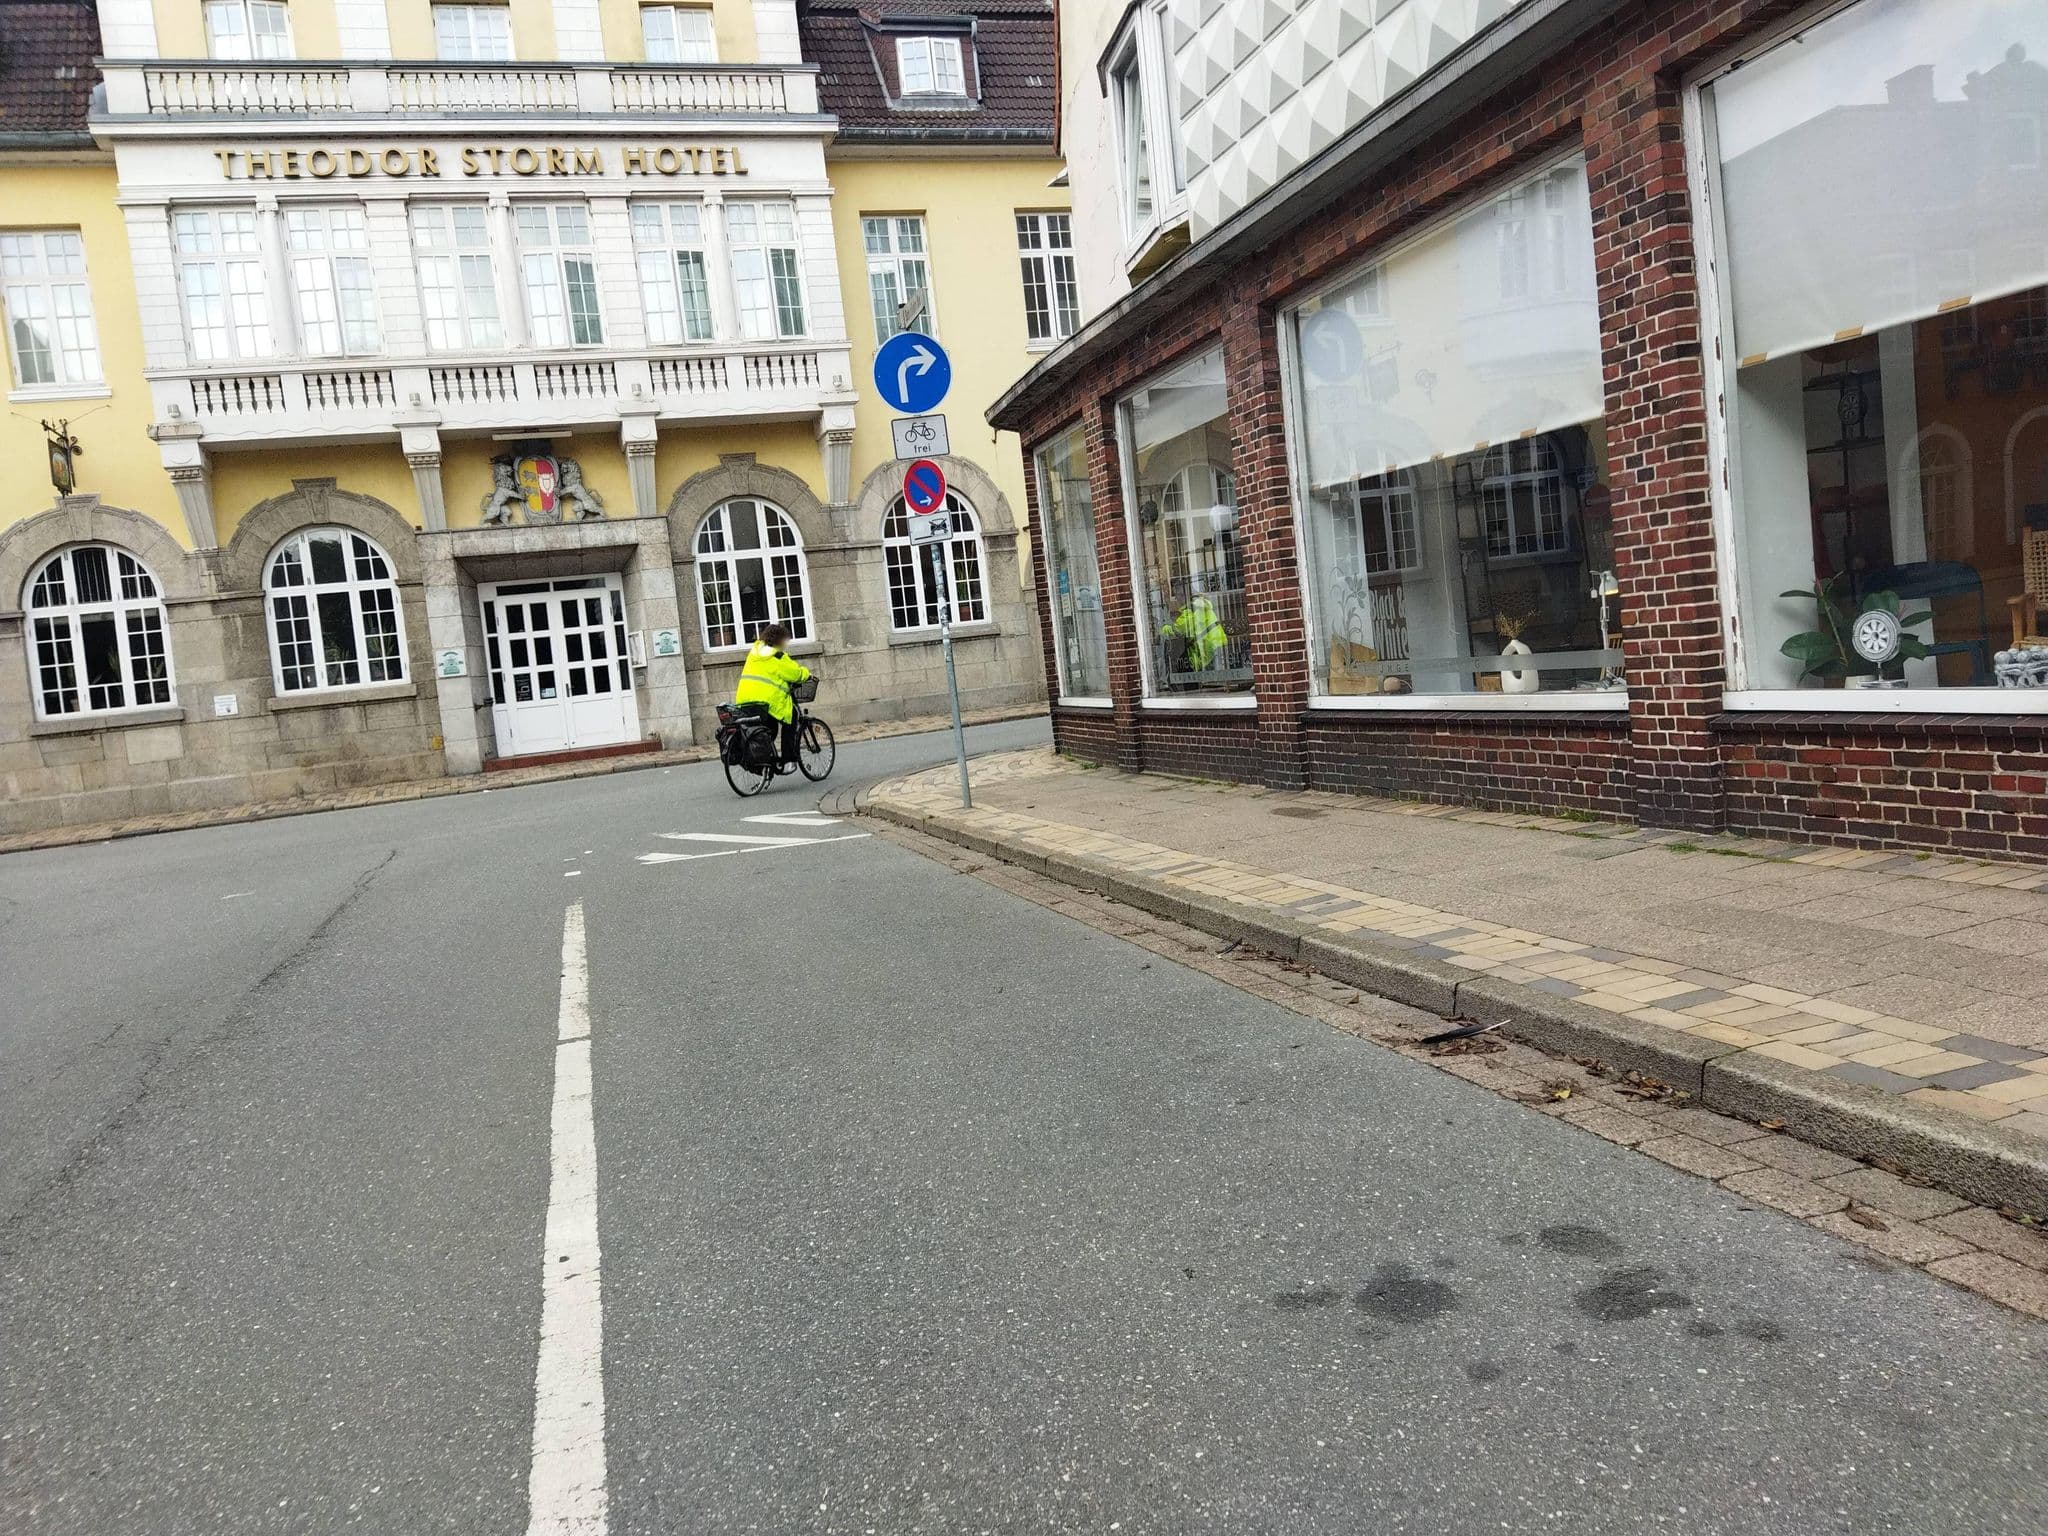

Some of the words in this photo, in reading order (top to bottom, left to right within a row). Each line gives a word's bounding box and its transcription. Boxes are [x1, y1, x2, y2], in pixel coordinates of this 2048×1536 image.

[214, 147, 440, 179] THEODOR
[460, 146, 604, 176] STORM
[621, 146, 749, 175] HOTEL
[913, 443, 932, 454] frei
